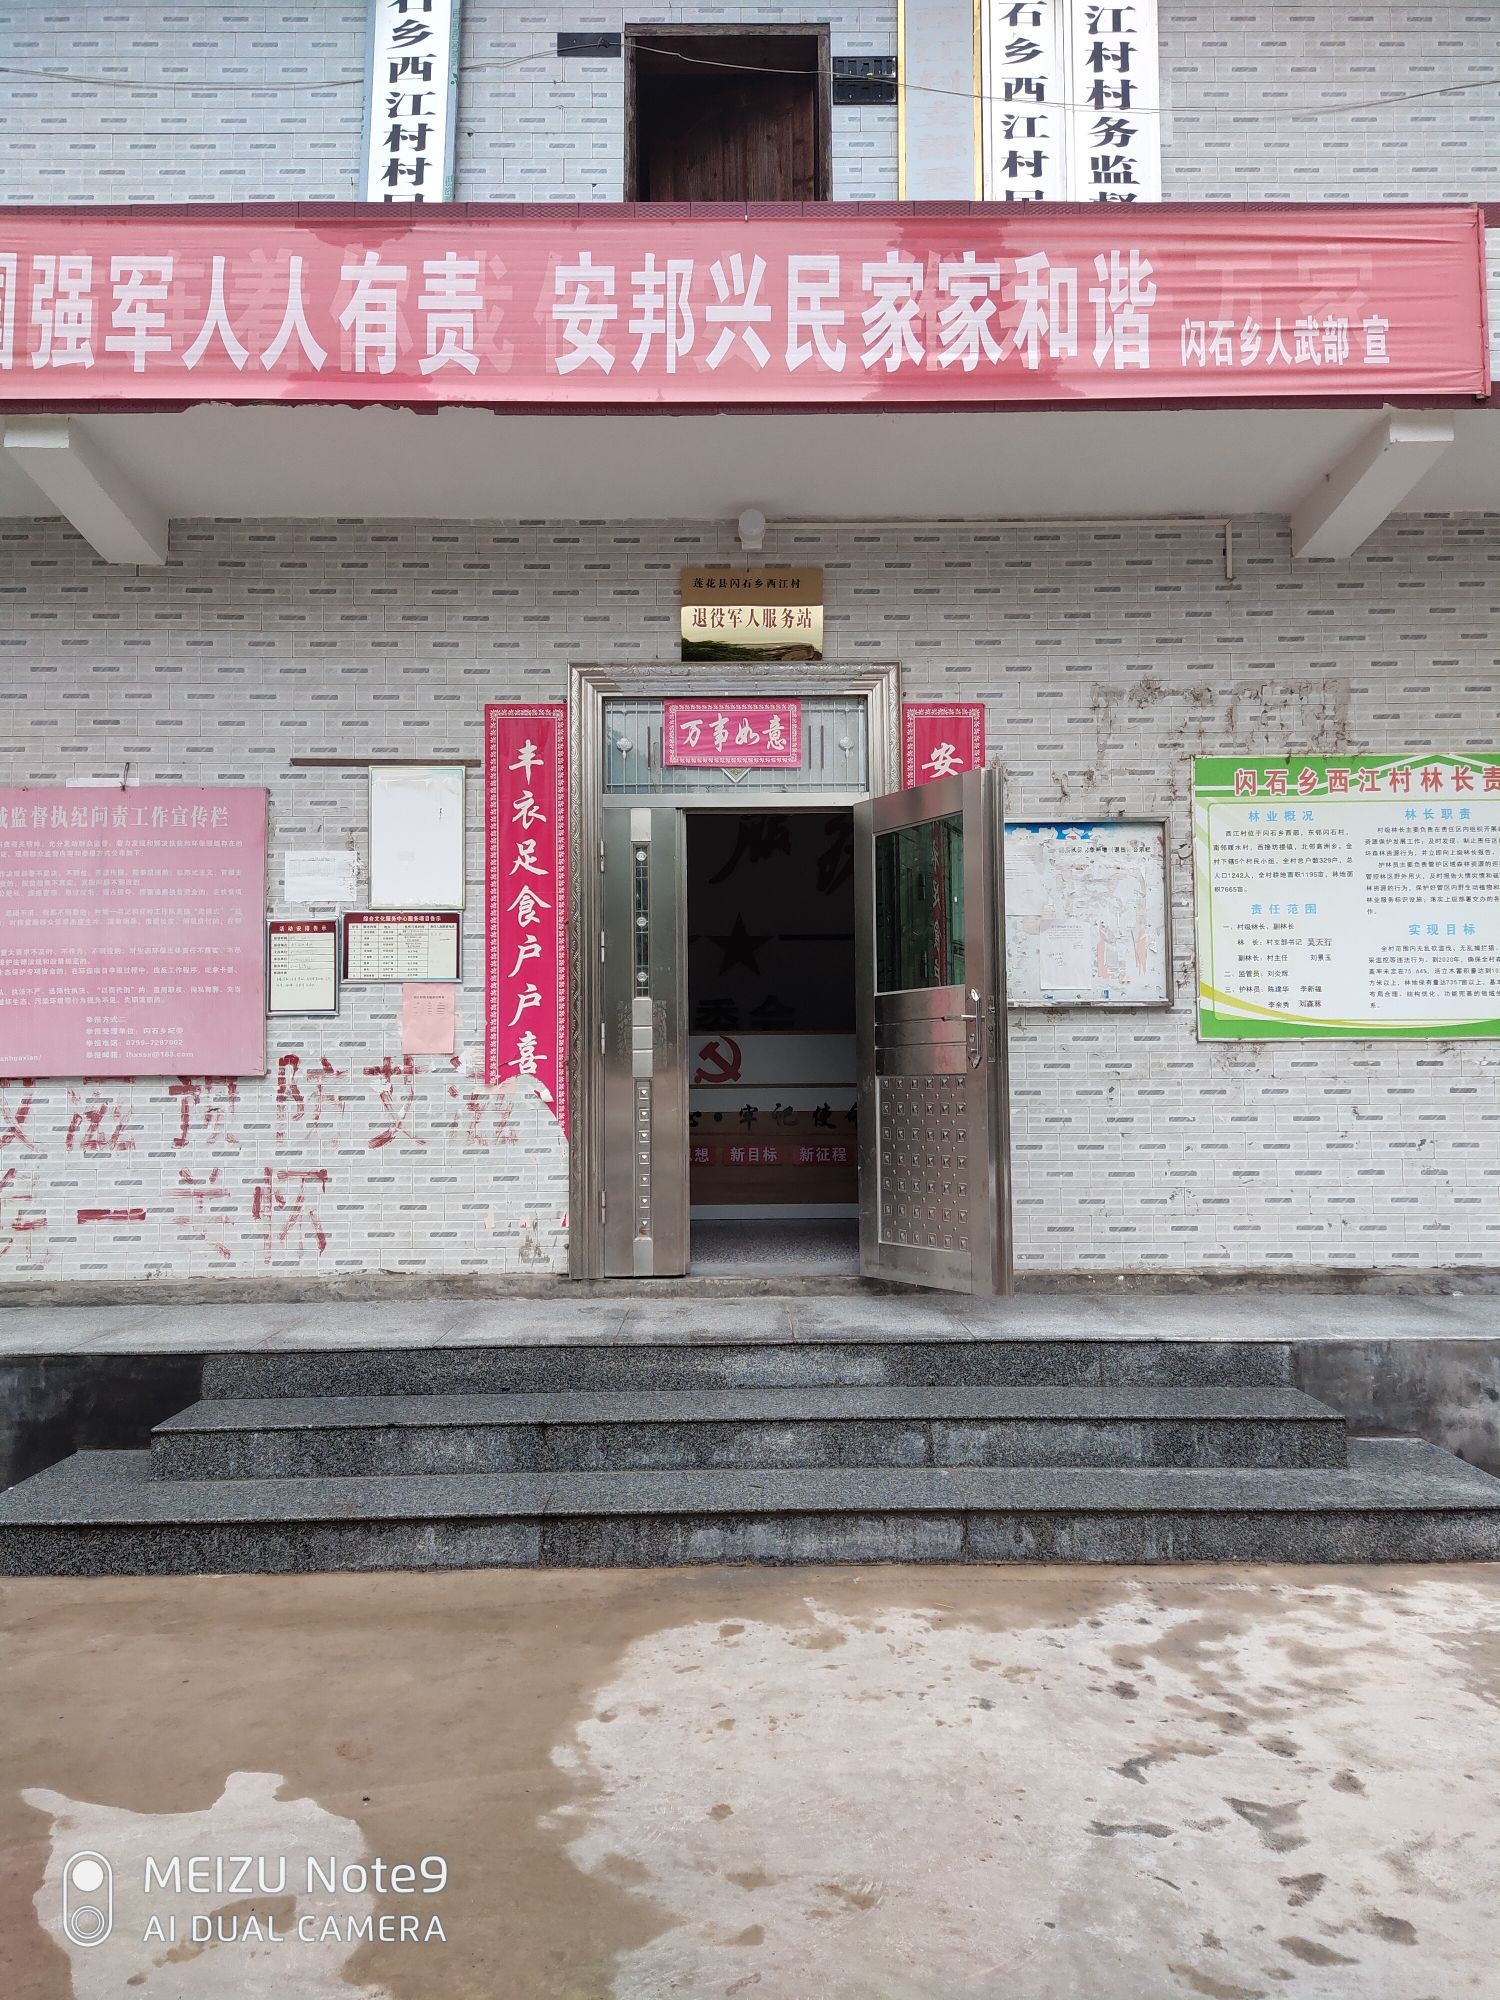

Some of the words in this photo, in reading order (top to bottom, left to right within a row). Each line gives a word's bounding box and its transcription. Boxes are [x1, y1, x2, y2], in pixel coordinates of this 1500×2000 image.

[552, 249, 1157, 375] 安邦兴民家家和谐
[1181, 315, 1349, 367] 闪石乡人武部
[1363, 314, 1391, 364] 宣
[693, 577, 801, 589] 莲花县闪石乡西江村
[692, 607, 812, 628] 退役军人服务站
[679, 712, 786, 752] 万事如意
[921, 742, 964, 778] 安
[1234, 766, 1500, 796] 闪石乡西江村林长责
[1248, 810, 1315, 822] 林业概况
[1404, 808, 1472, 820] 林长职责
[507, 739, 552, 1075] 丰衣足食户户喜
[1251, 903, 1317, 915] 责任范围
[1409, 923, 1477, 936] 实现目标
[690, 1147, 710, 1162] 想
[730, 1147, 778, 1162] 新目标
[799, 1147, 848, 1162] 新征程
